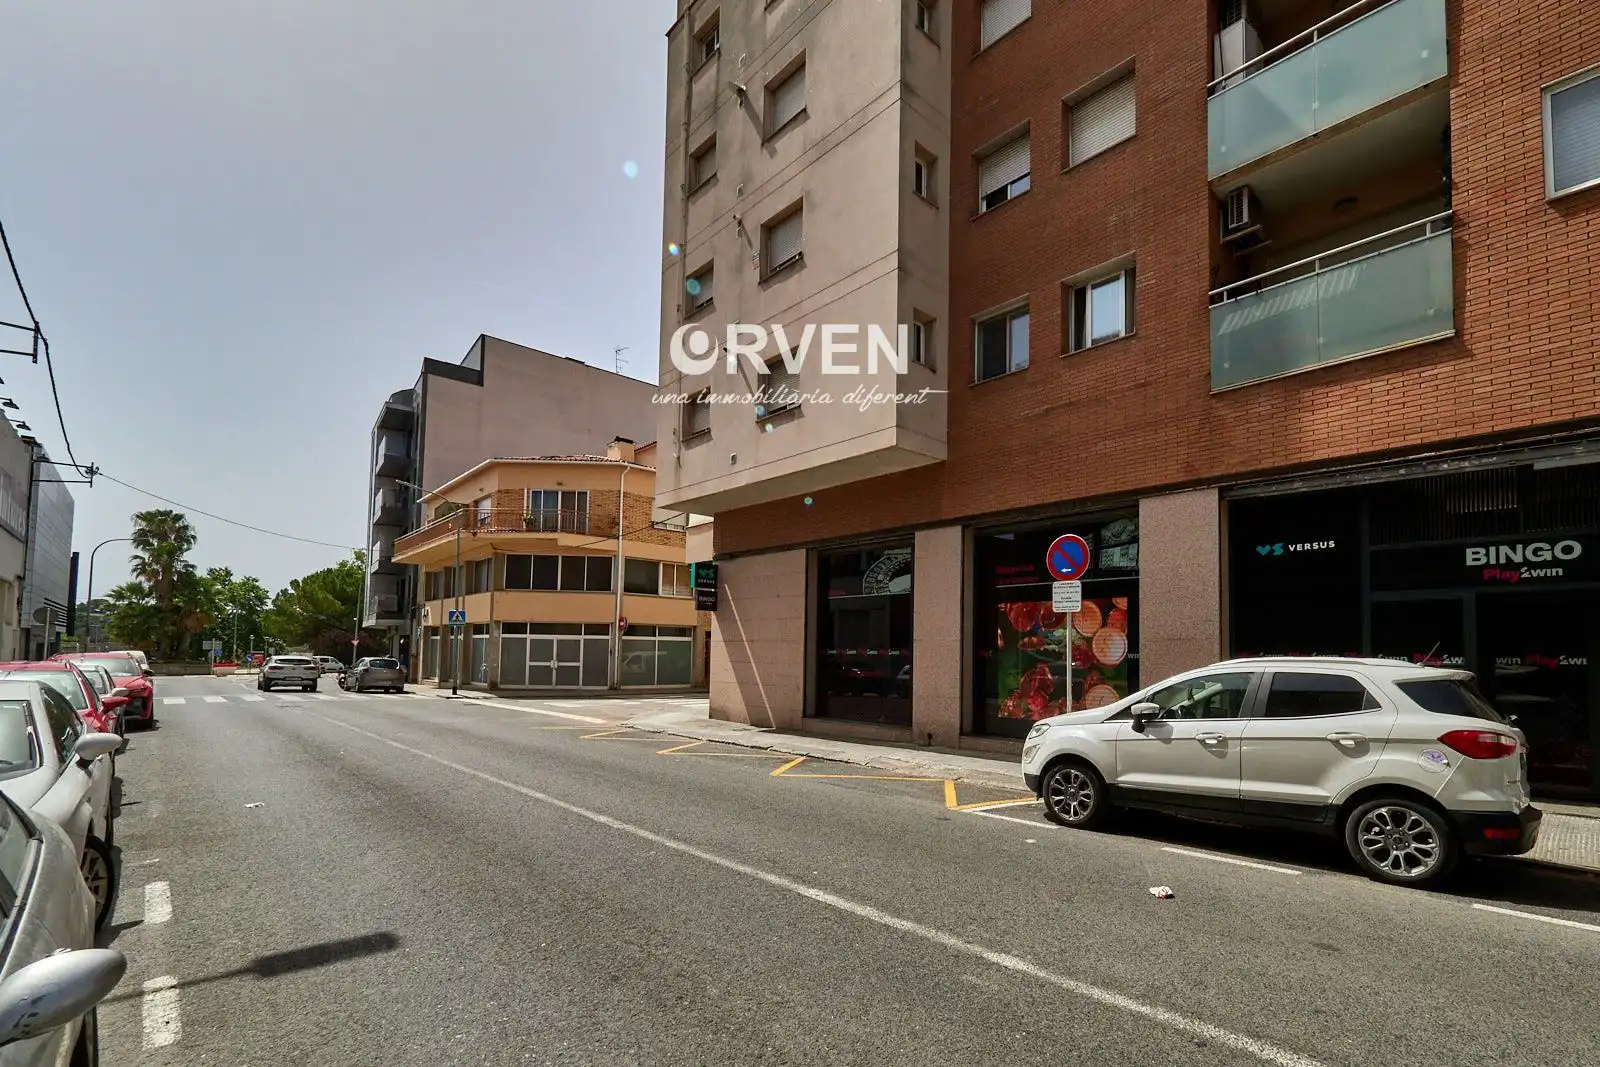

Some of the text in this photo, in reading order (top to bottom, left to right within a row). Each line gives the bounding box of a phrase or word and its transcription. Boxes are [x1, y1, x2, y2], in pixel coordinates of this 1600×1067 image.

[1288, 540, 1335, 551] VERSUS
[1465, 540, 1582, 566] BINGO
[1483, 566, 1563, 584] Play2win
